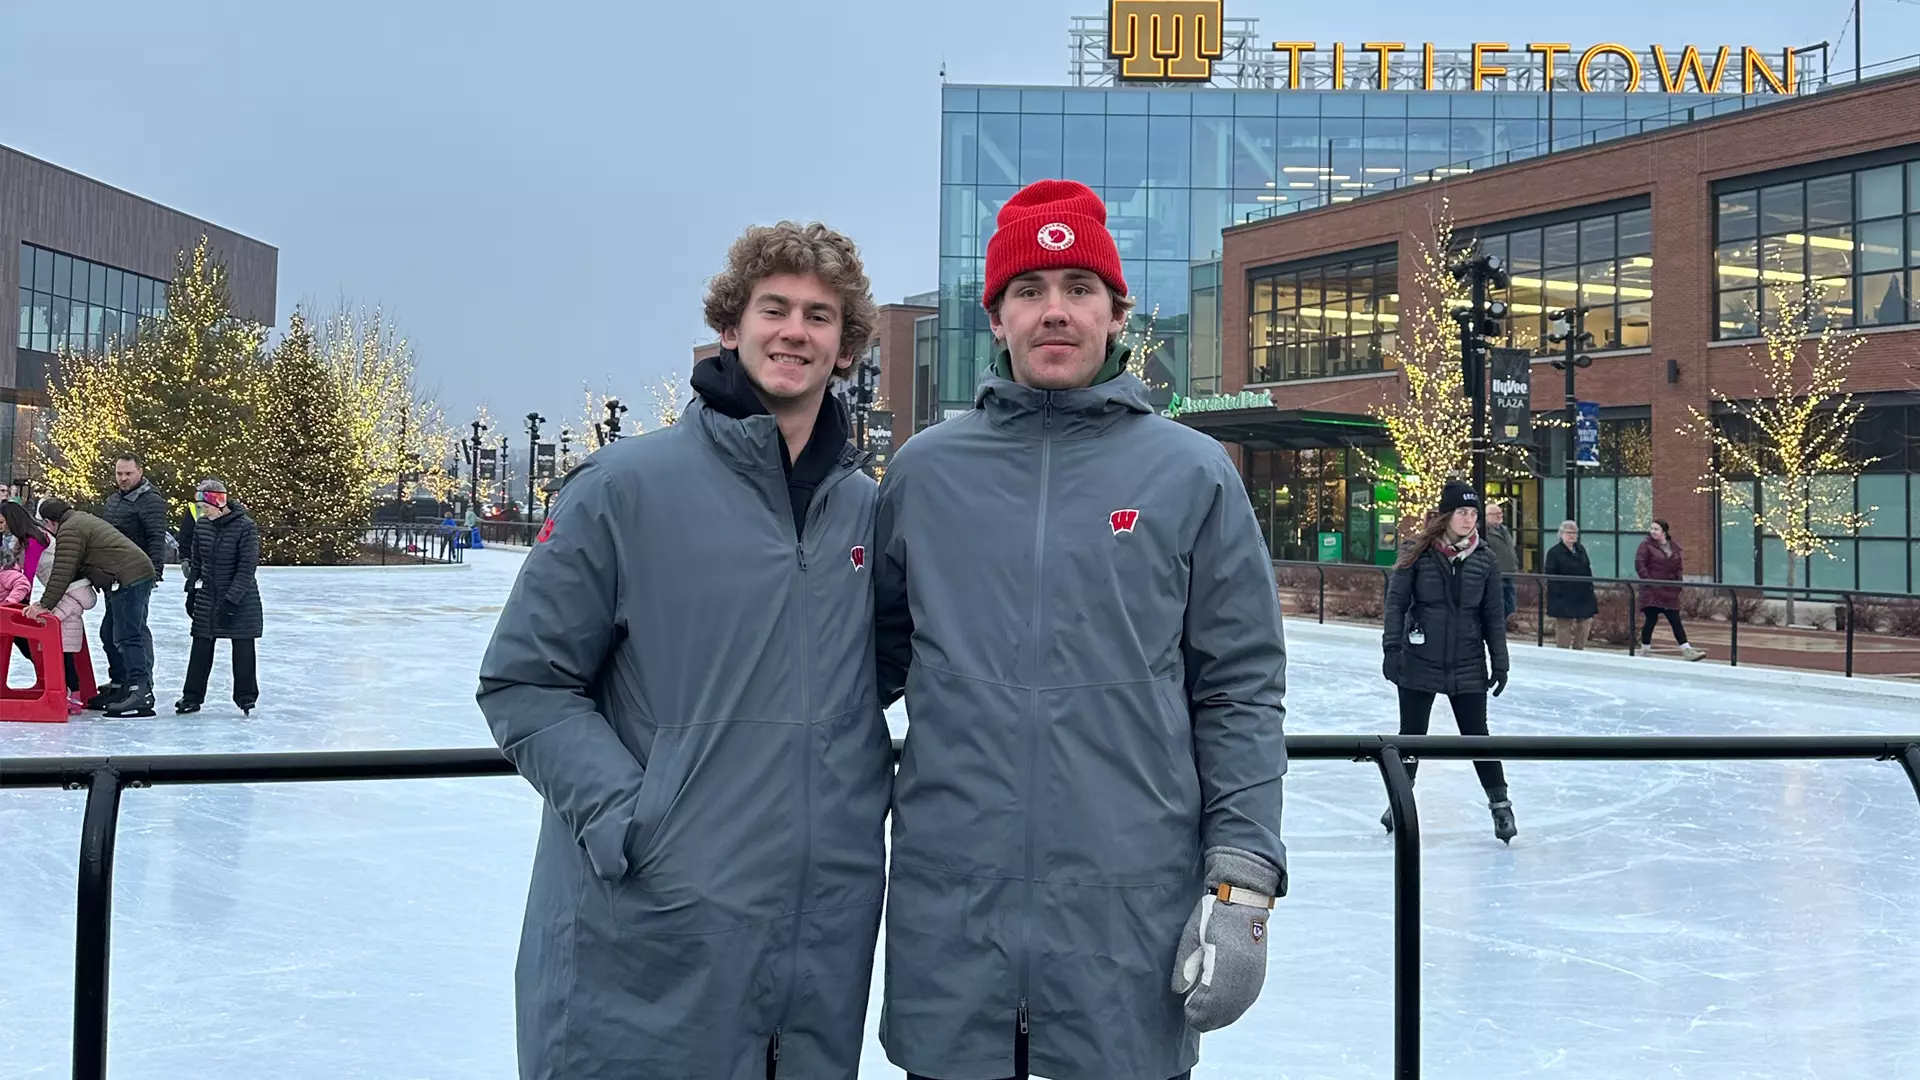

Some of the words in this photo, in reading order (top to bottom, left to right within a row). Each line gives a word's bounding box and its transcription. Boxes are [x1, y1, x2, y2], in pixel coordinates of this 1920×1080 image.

[1273, 41, 1796, 95] TITLETOWN
[1497, 398, 1525, 408] PLAZA
[1109, 508, 1140, 536] W
